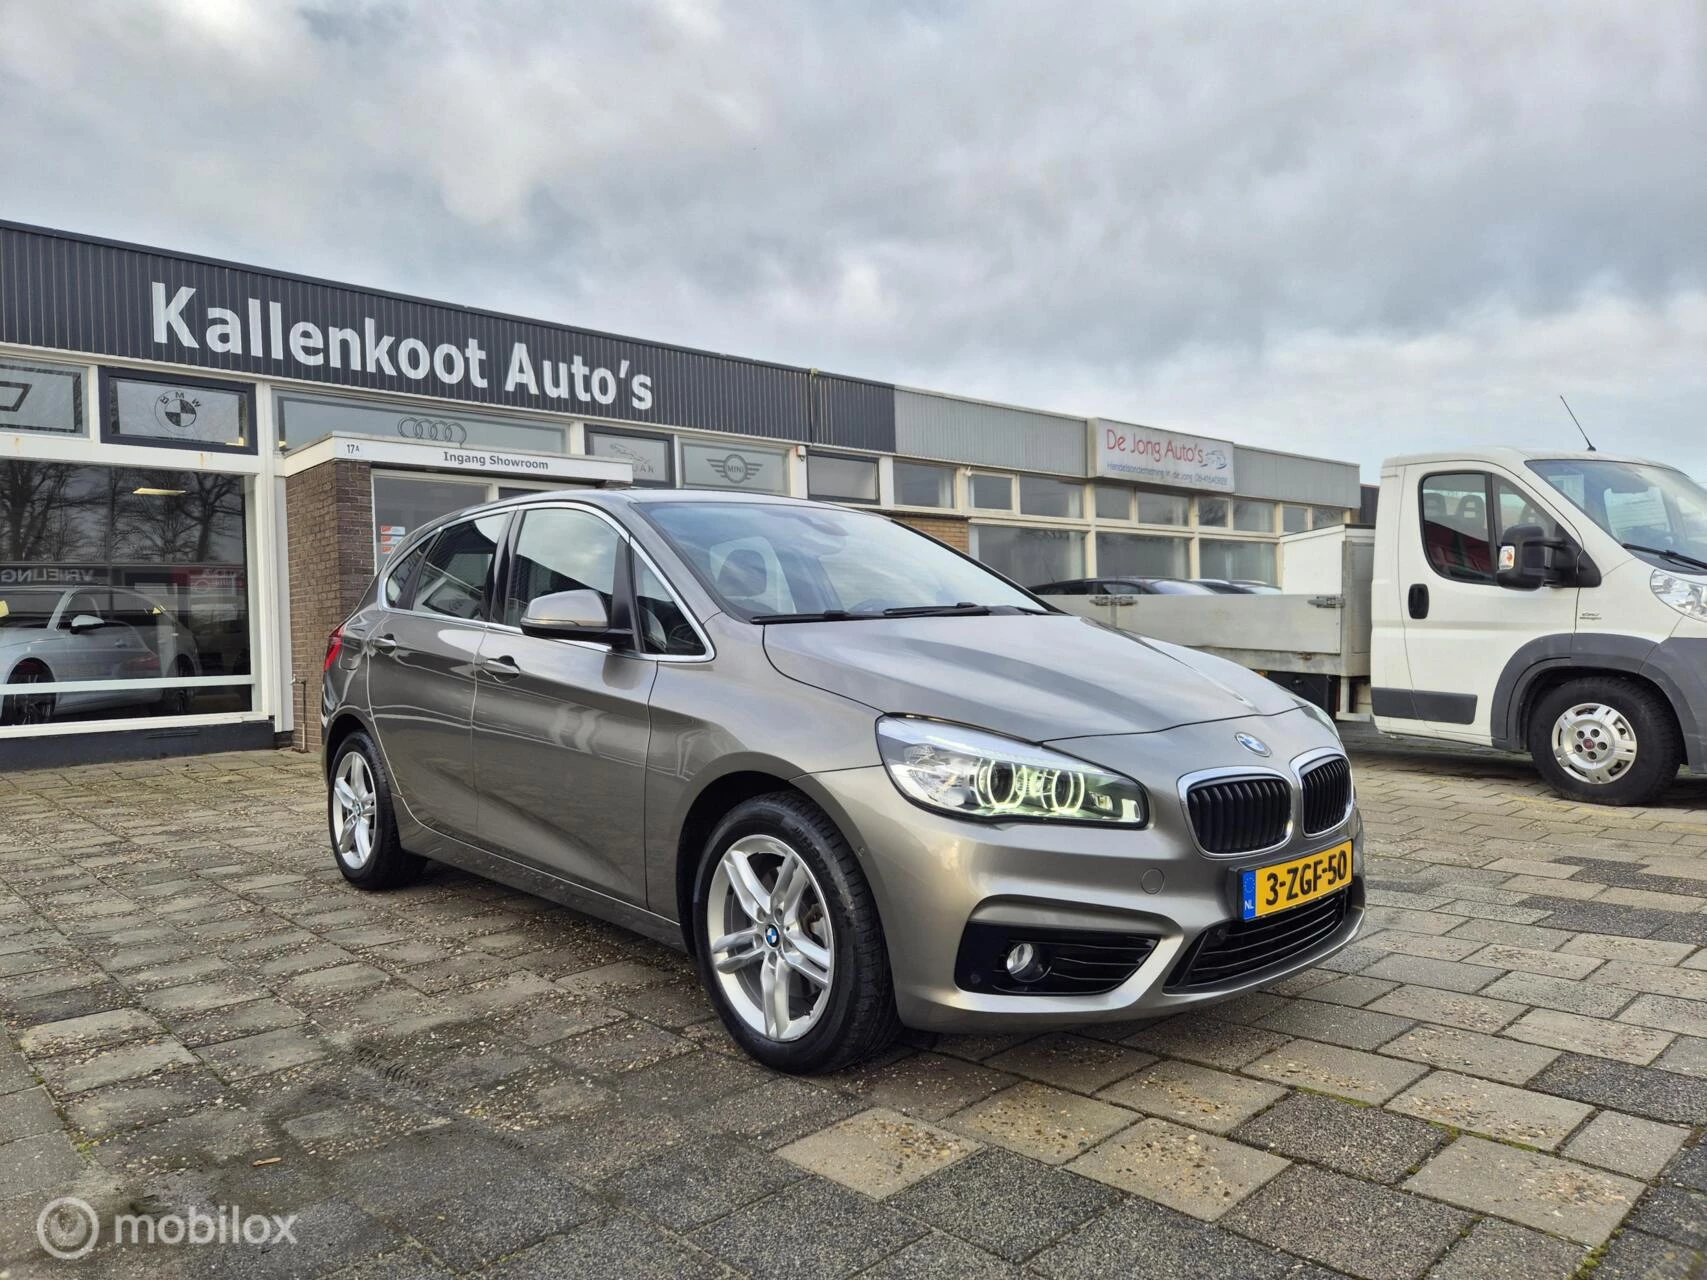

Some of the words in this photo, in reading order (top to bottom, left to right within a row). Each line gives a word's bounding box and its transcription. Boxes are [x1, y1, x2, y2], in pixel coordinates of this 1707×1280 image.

[151, 281, 488, 389] Kallenkoot
[504, 342, 653, 411] Auto's
[346, 444, 360, 454] 17A
[1106, 429, 1126, 452] De
[1131, 432, 1161, 462] Jong
[1164, 440, 1204, 464] Auto's
[443, 451, 486, 466] Ingang
[489, 455, 549, 470] Showroom
[1265, 850, 1347, 906] 3-ZGF-50
[1244, 901, 1254, 910] NL
